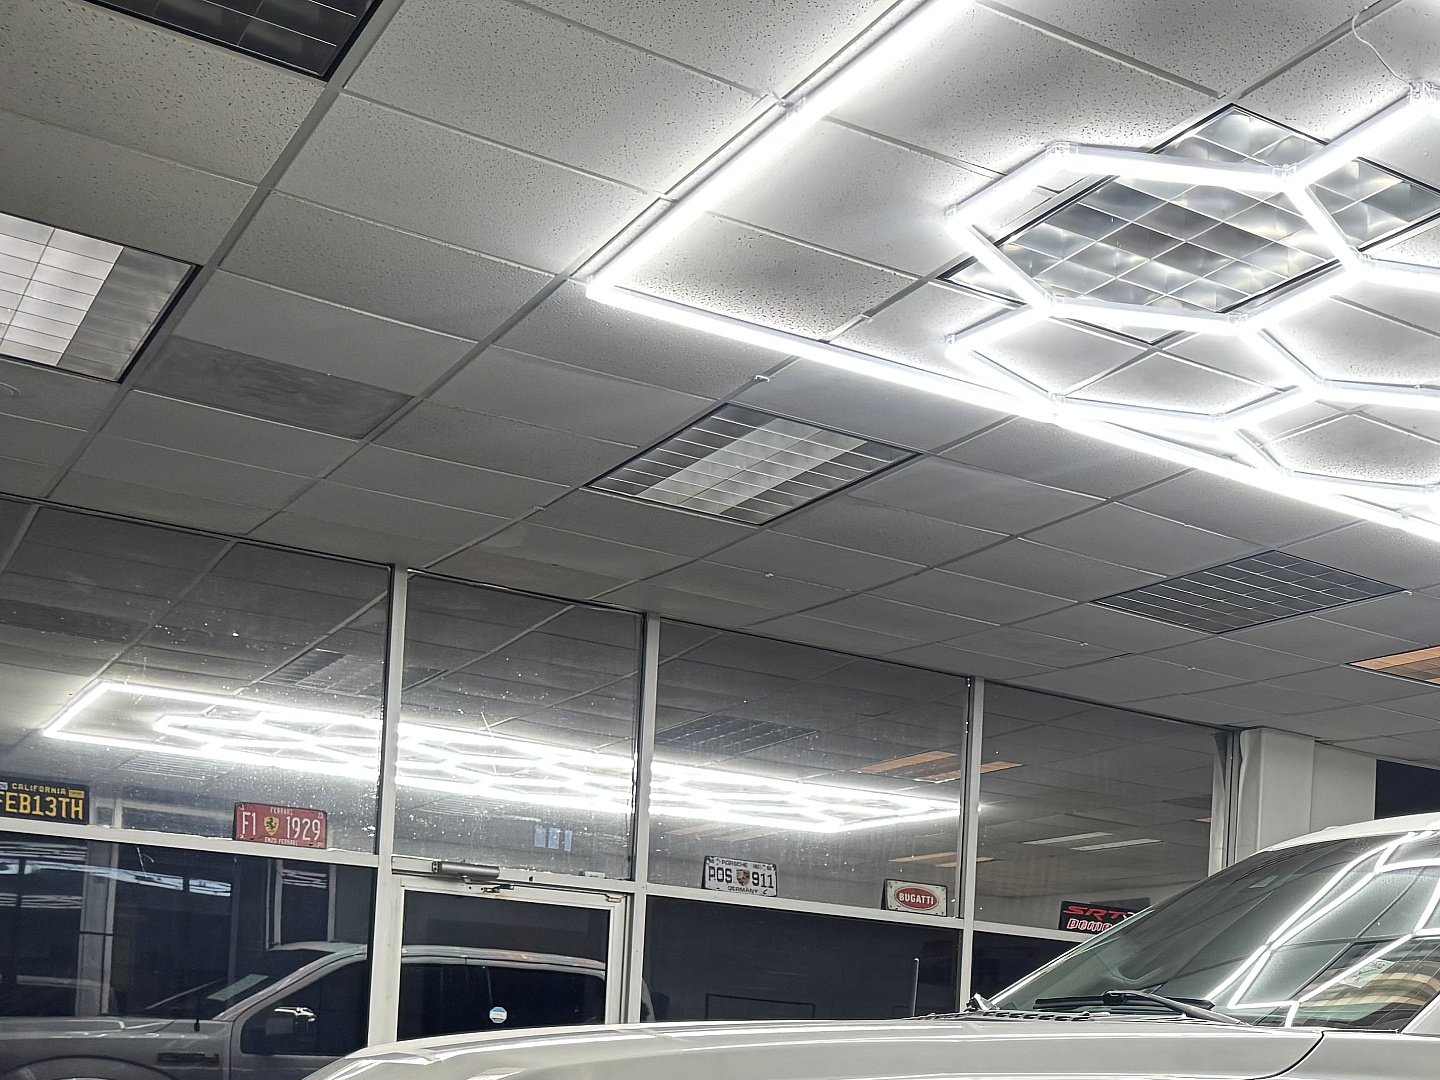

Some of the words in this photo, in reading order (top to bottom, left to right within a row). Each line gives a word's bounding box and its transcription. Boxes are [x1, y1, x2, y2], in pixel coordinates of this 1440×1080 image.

[12, 783, 67, 796] CALIFORNIA
[242, 811, 256, 836] F1
[286, 816, 321, 841] 1929
[751, 871, 775, 889] 911
[727, 885, 759, 894] GERMANY
[898, 892, 934, 905] BUGATTI
[1063, 905, 1127, 921] SRT
